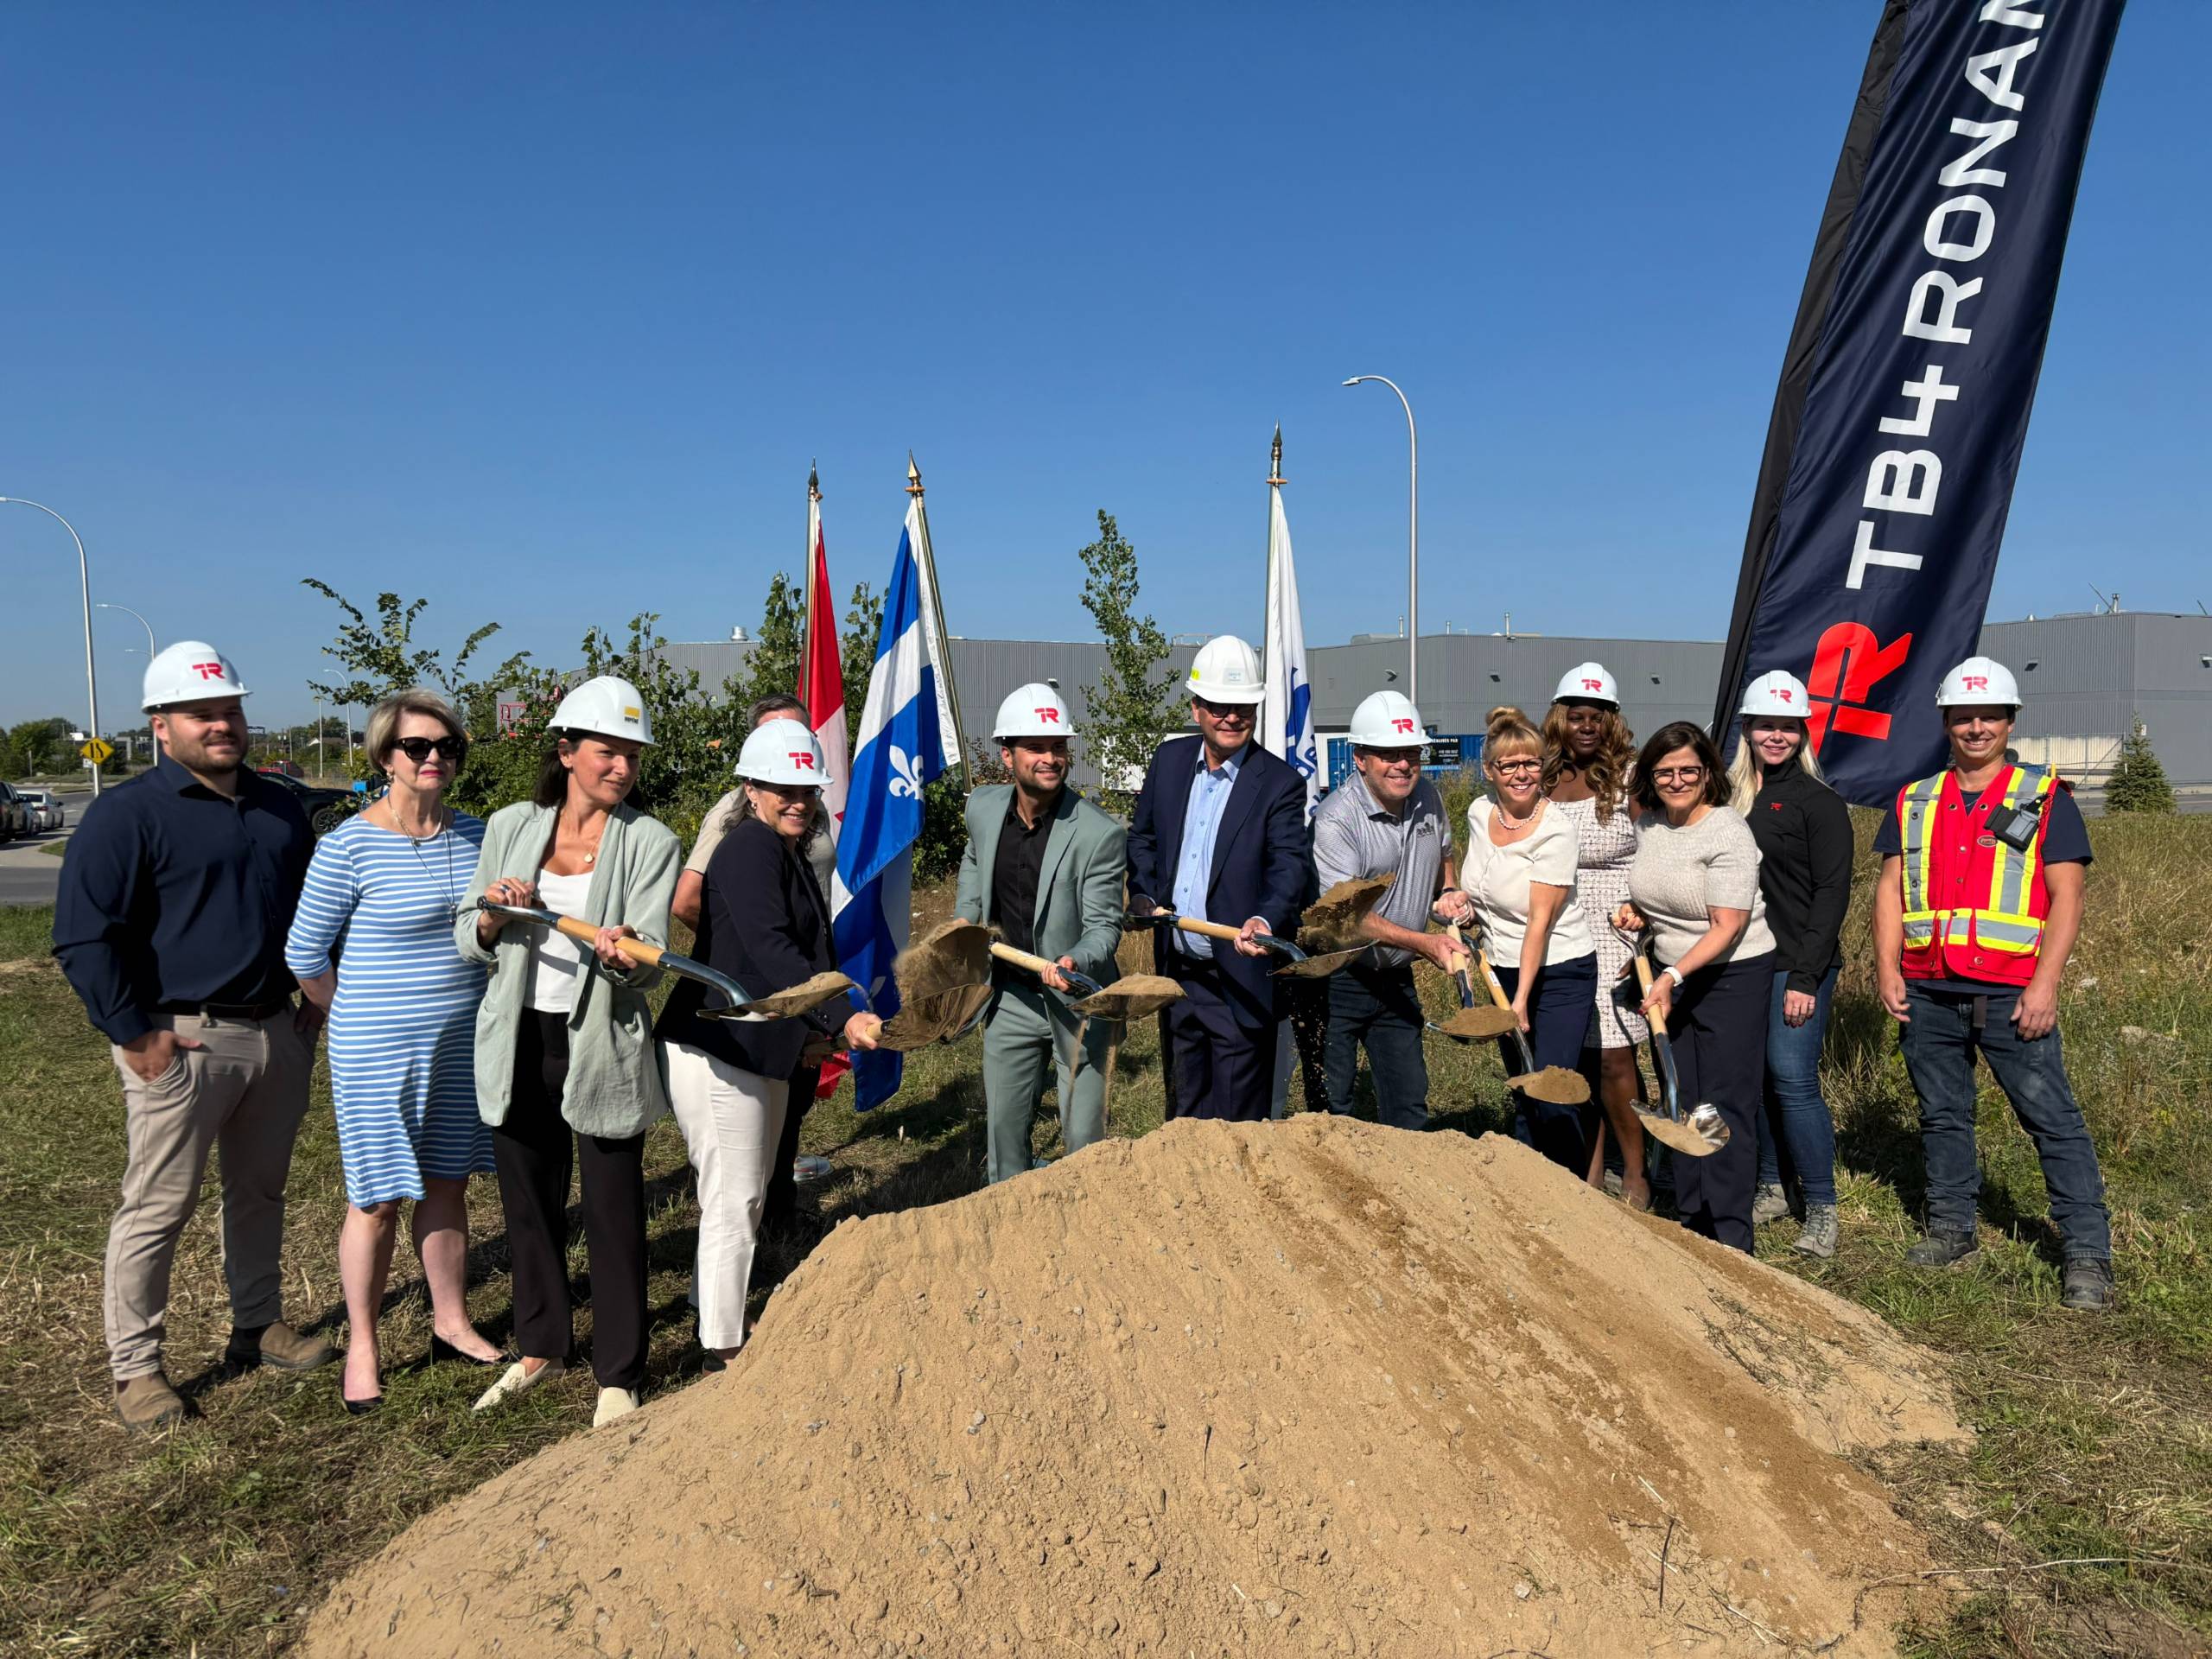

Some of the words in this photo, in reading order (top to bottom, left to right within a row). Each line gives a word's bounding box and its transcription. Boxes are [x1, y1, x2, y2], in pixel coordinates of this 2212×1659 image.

[192, 663, 226, 680] TR
[1581, 678, 1602, 692] TR
[1961, 677, 1988, 690] TR
[1034, 708, 1059, 723] TR
[1391, 718, 1414, 734] TR
[788, 752, 815, 770] TR
